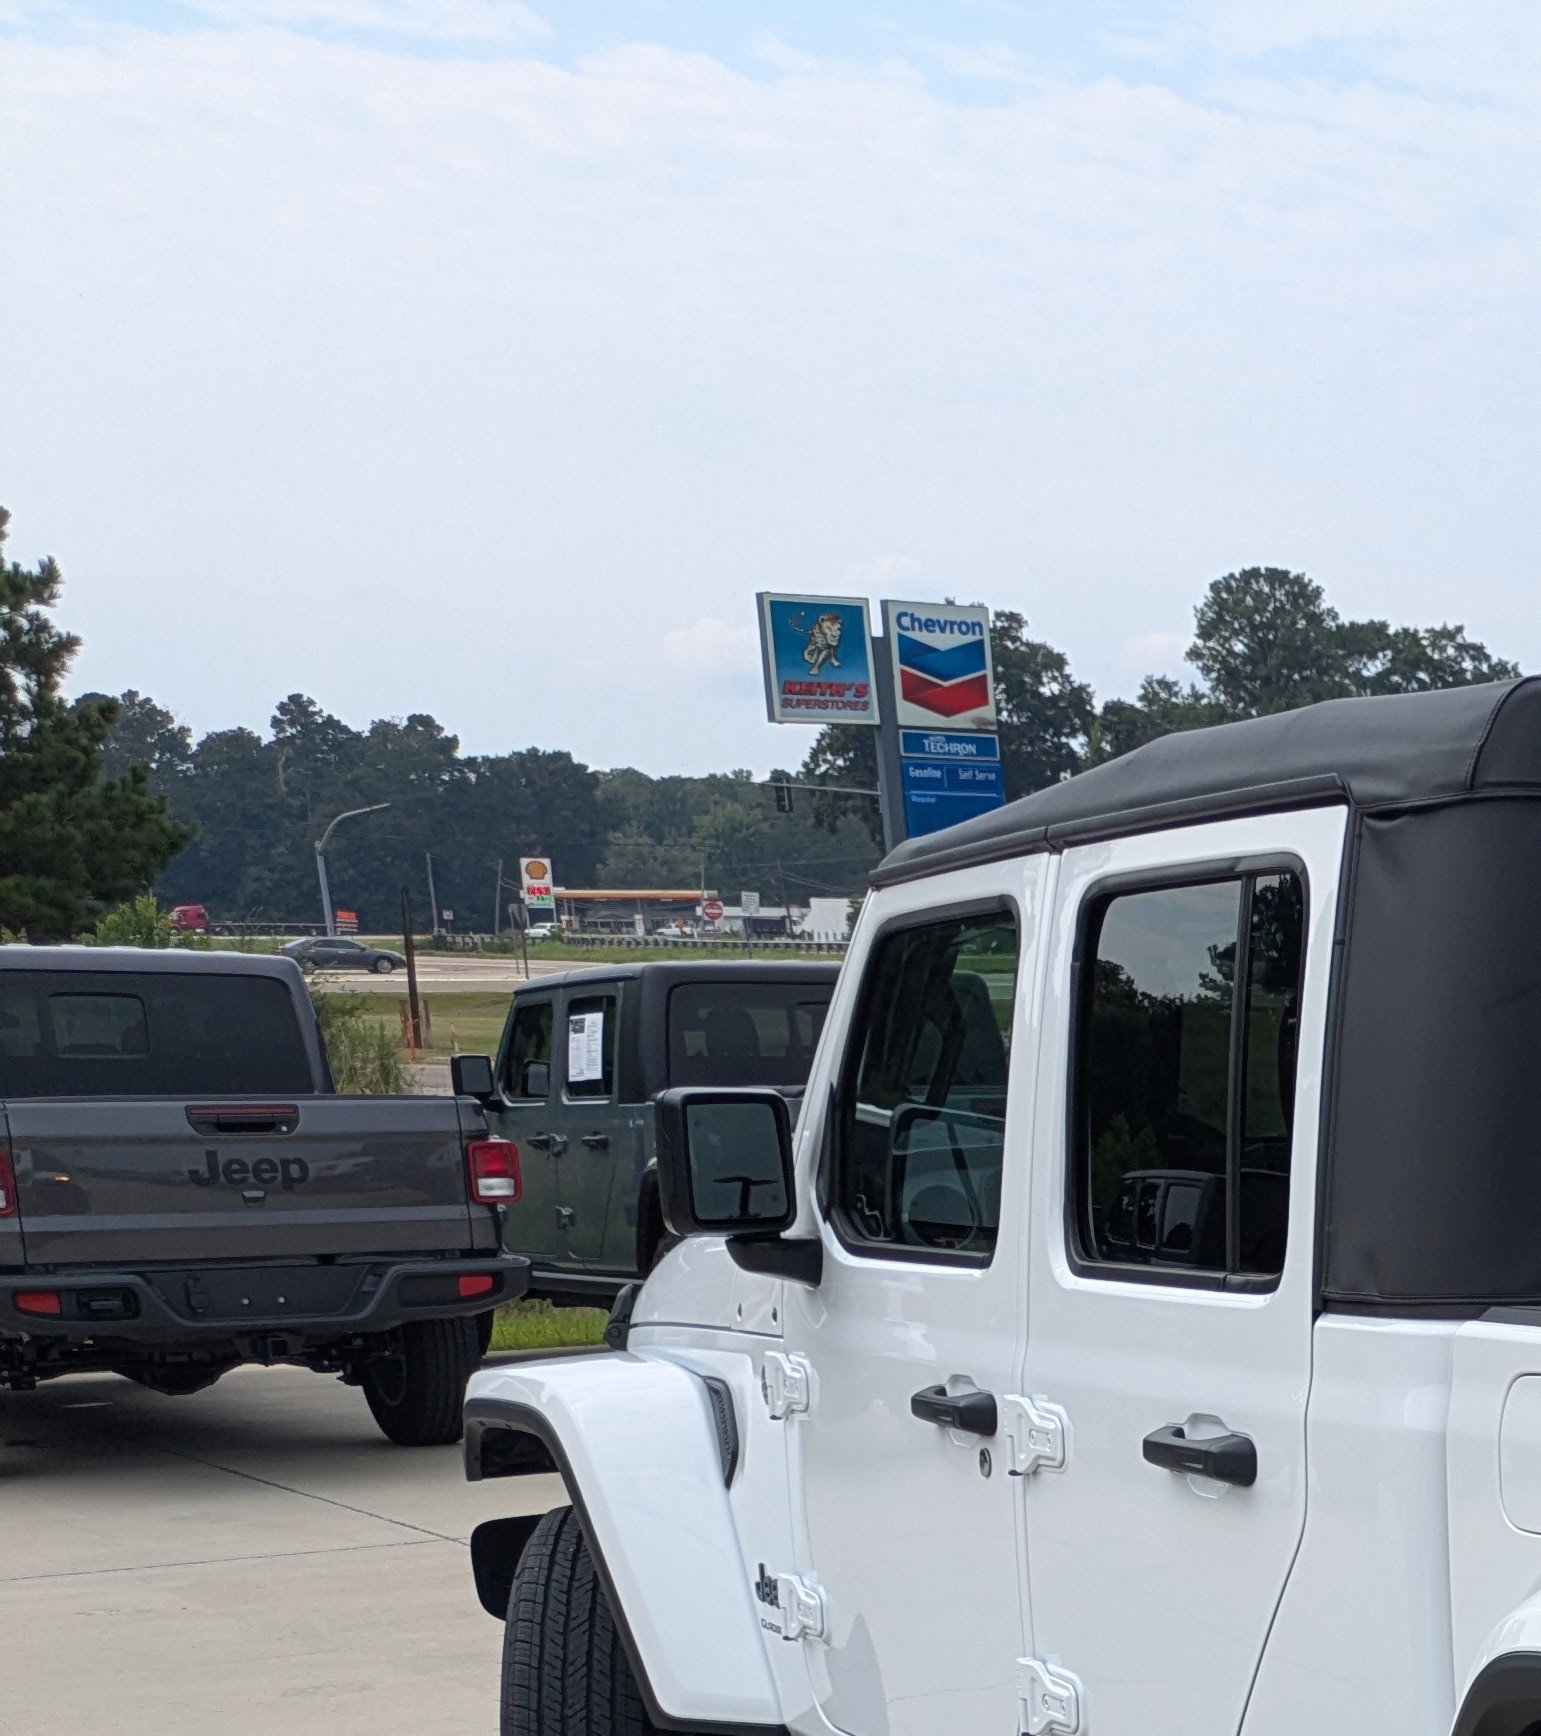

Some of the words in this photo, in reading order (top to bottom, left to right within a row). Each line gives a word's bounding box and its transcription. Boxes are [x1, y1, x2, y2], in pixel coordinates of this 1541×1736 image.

[896, 611, 984, 637] Chevron
[923, 739, 977, 756] TECHRON
[188, 1149, 310, 1191] Jeep
